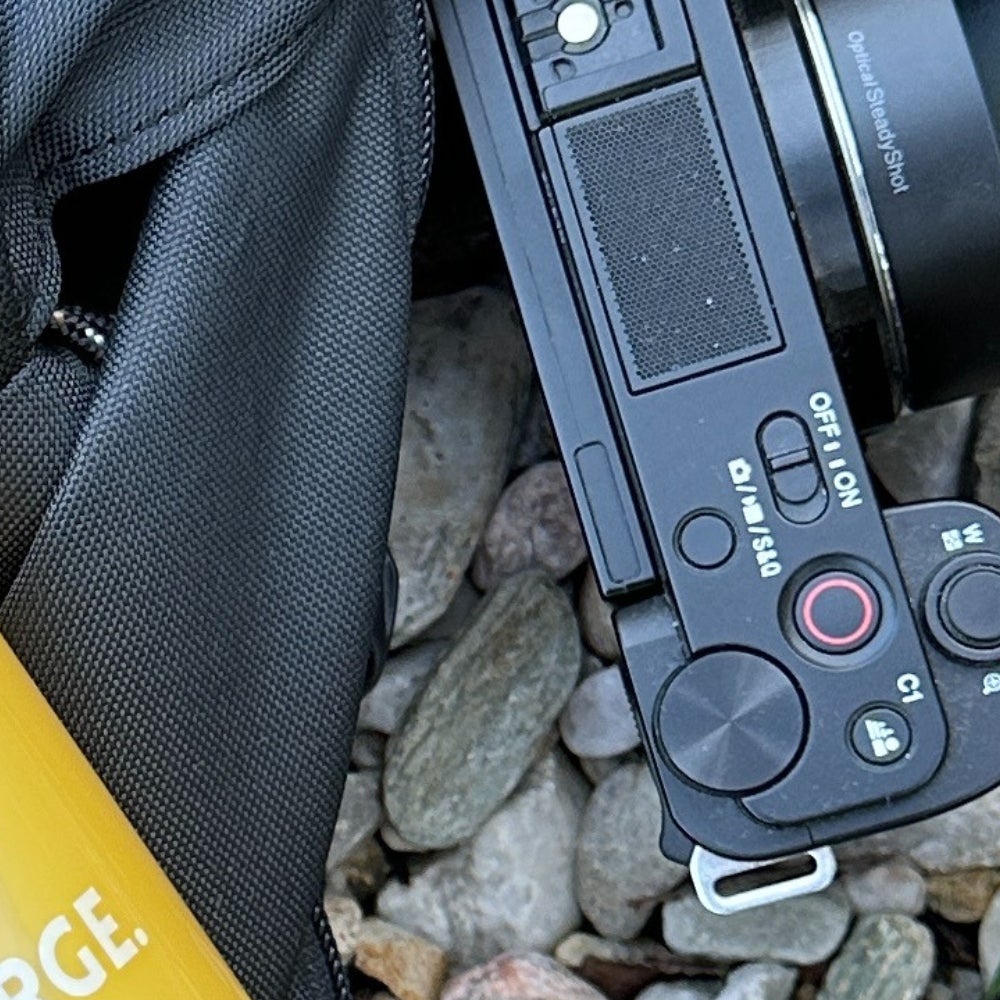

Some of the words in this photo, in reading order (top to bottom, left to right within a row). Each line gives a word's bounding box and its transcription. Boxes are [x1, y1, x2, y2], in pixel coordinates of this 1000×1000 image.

[809, 391, 841, 439] OFF
[833, 471, 863, 508] ON
[897, 673, 924, 703] C1
